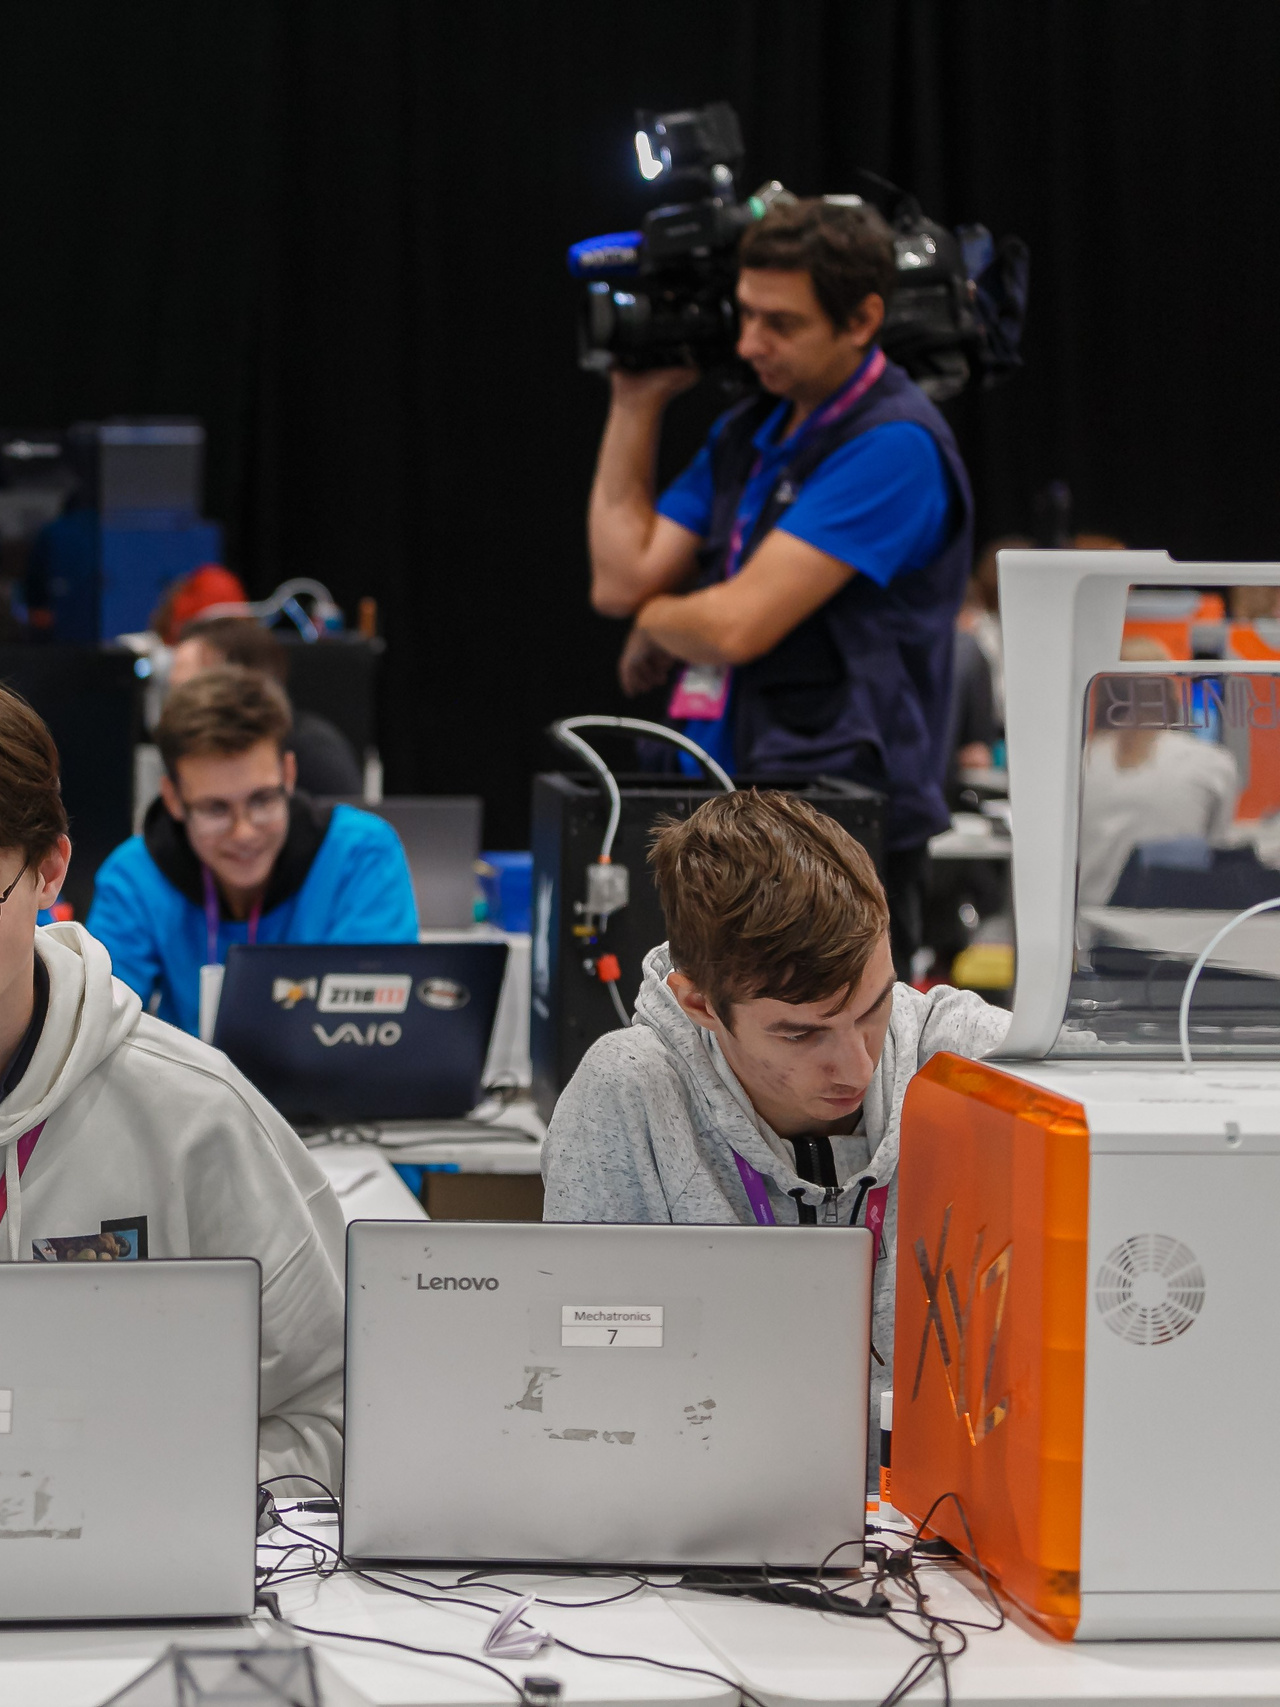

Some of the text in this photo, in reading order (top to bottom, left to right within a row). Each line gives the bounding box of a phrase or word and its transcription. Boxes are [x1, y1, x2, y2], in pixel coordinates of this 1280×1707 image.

[1102, 679, 1280, 729] RINTER
[312, 1021, 402, 1046] VAIO
[416, 1274, 500, 1293] Lenovo
[574, 1309, 652, 1323] Mechatronics
[912, 1201, 1013, 1447] XYZ
[607, 1330, 618, 1345] 7
